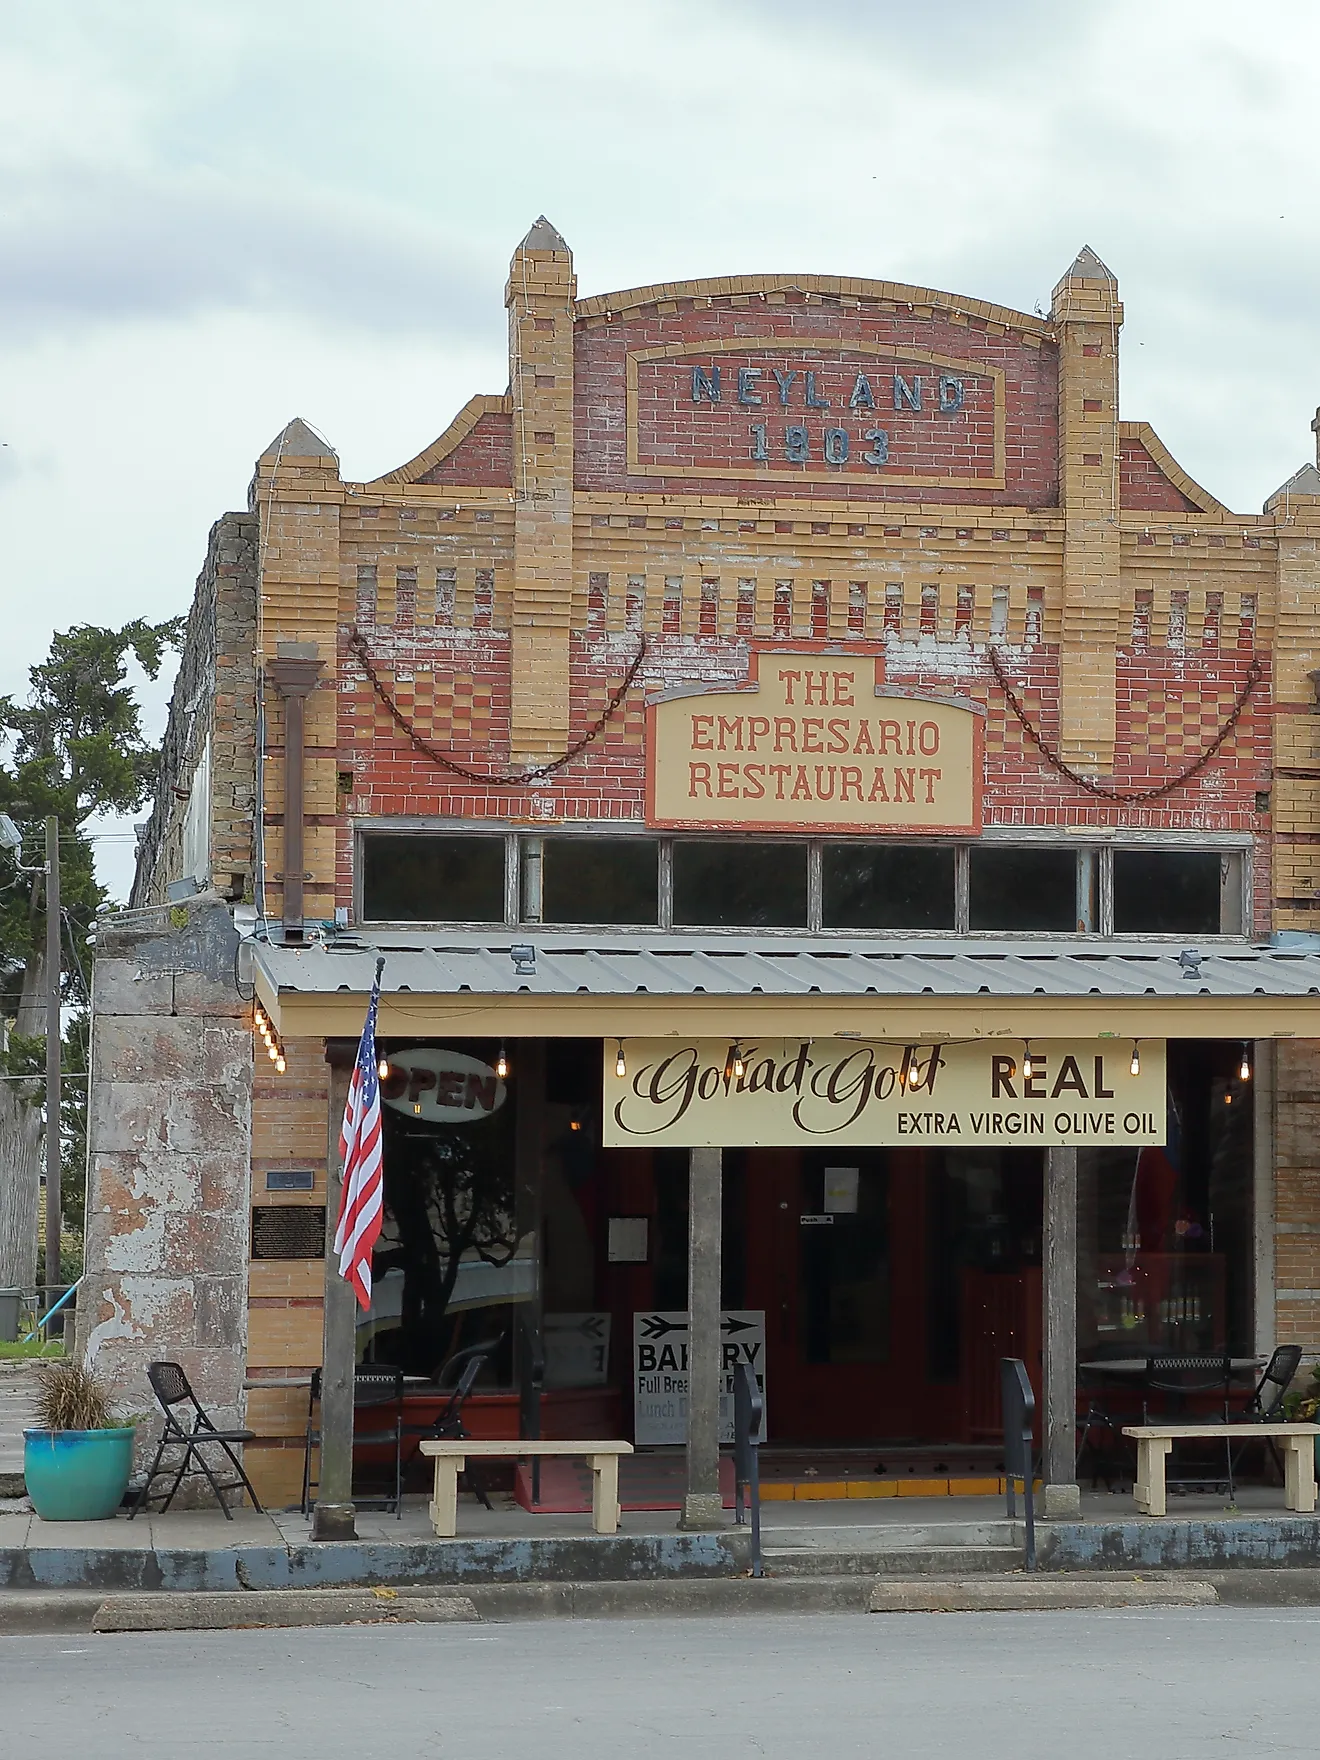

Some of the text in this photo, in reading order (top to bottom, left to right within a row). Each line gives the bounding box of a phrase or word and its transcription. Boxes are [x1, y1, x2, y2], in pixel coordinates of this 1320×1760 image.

[692, 365, 965, 413] NEYLAND
[751, 423, 889, 466] 1903
[778, 670, 855, 707] THE
[690, 714, 941, 757] EMPRESARIO
[688, 761, 942, 804] RESTAURANT
[380, 1064, 497, 1111] OPEN
[614, 1041, 946, 1134] Goliad Gold
[990, 1054, 1115, 1099] REAL
[897, 1112, 1157, 1134] EXTRA VIRGIN OLIVE OIL
[638, 1376, 660, 1393] Full
